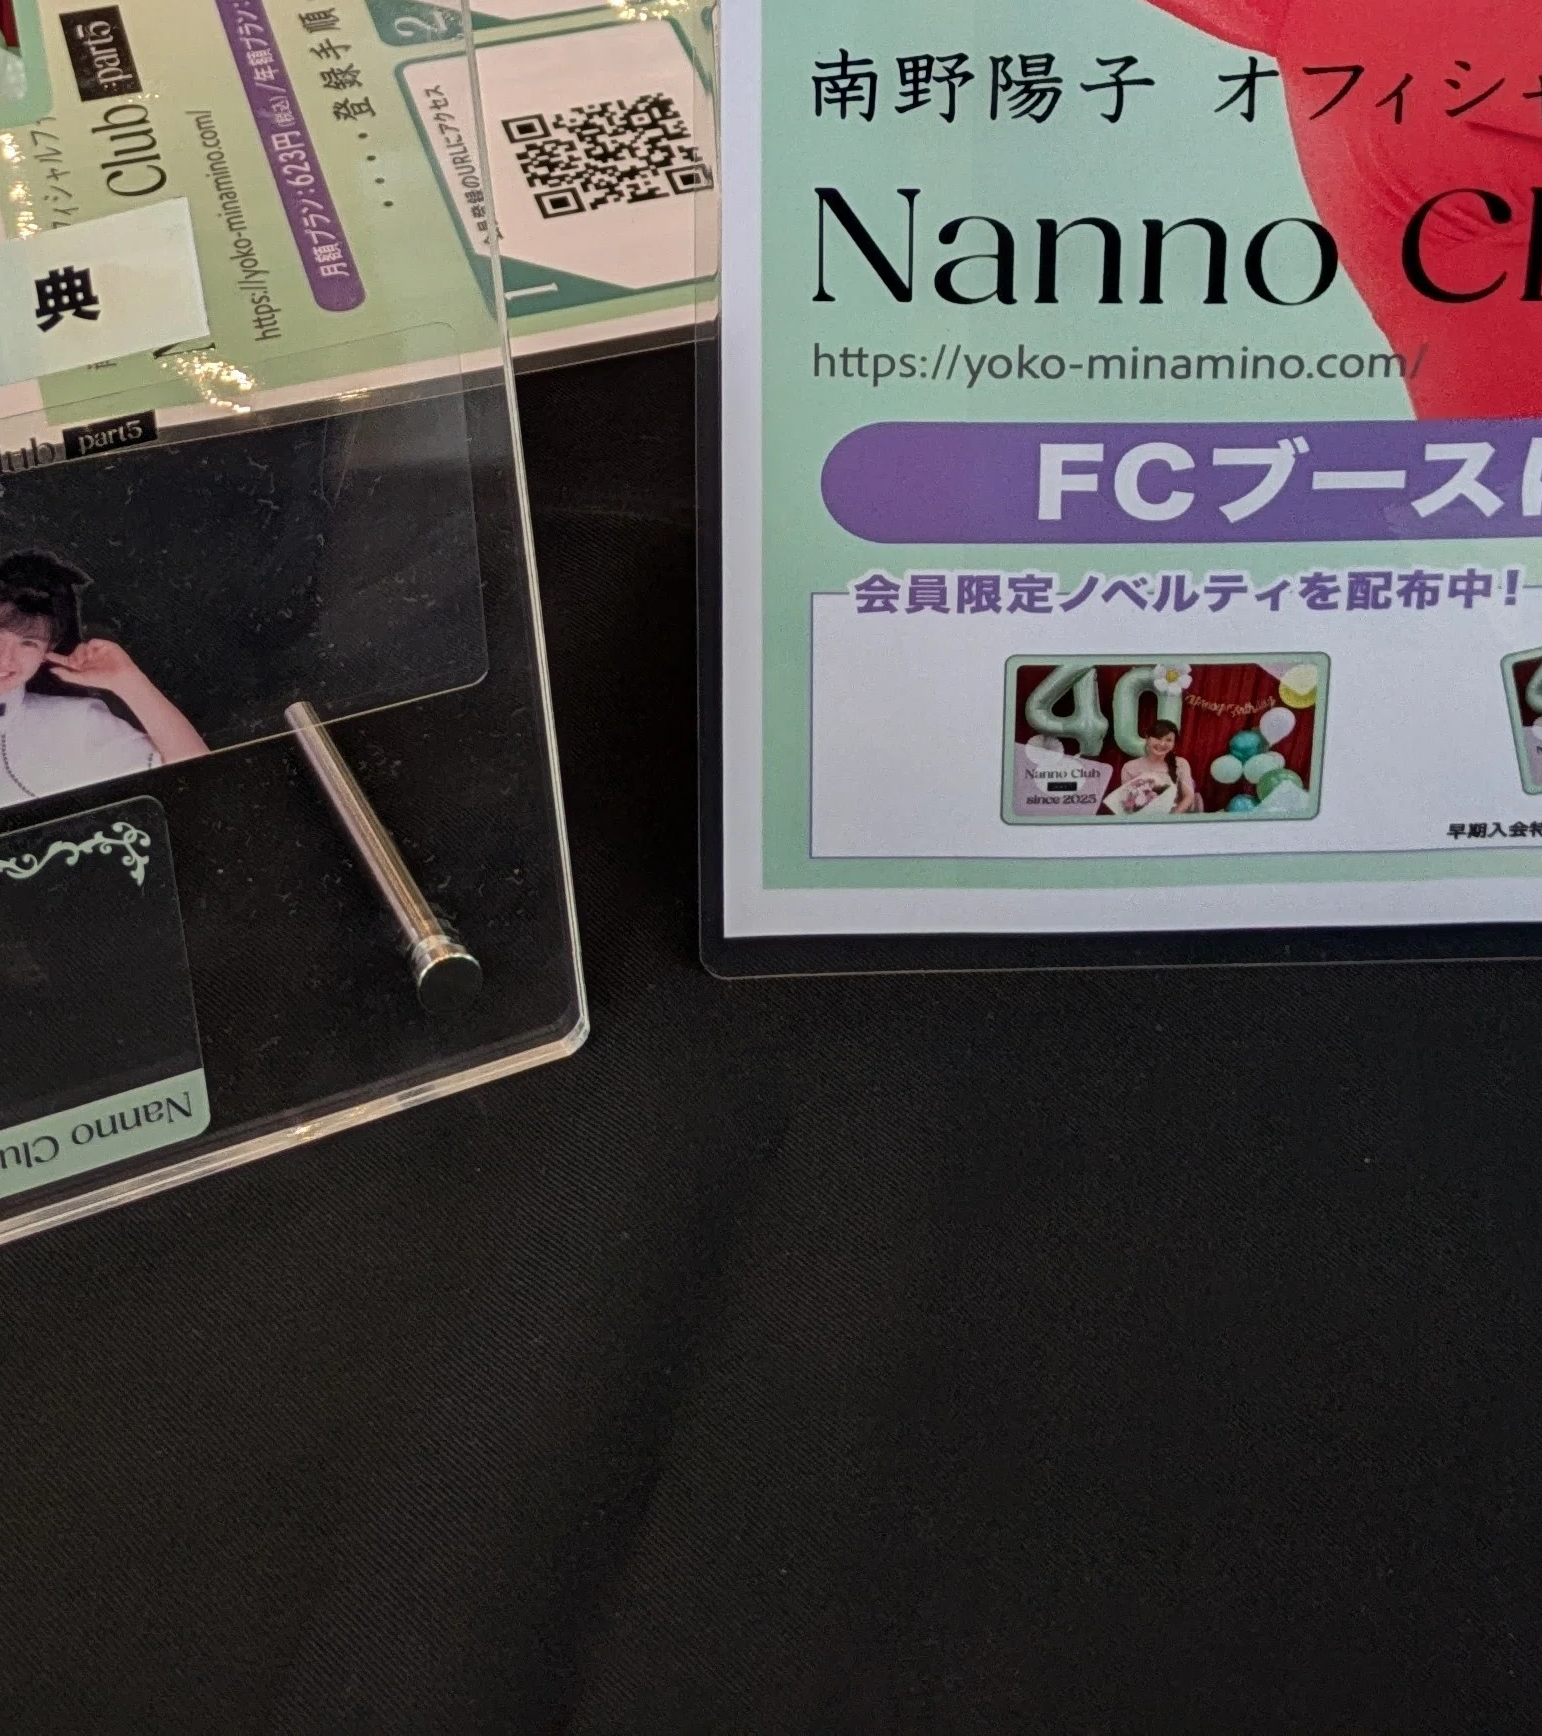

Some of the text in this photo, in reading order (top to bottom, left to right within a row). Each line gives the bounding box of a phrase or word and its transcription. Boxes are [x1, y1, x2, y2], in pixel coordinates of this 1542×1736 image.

[78, 20, 169, 199] Club part5
[810, 47, 1156, 126] 南野陽子
[185, 108, 283, 342] https://yoko-minamino.com/
[812, 186, 1340, 307] Nanno
[811, 342, 1429, 389] https://yoko-minamino.com/
[78, 419, 144, 455] part5
[853, 567, 1524, 615] 会員限定ノベルティを配布中!
[70, 1090, 193, 1147] Nanno
